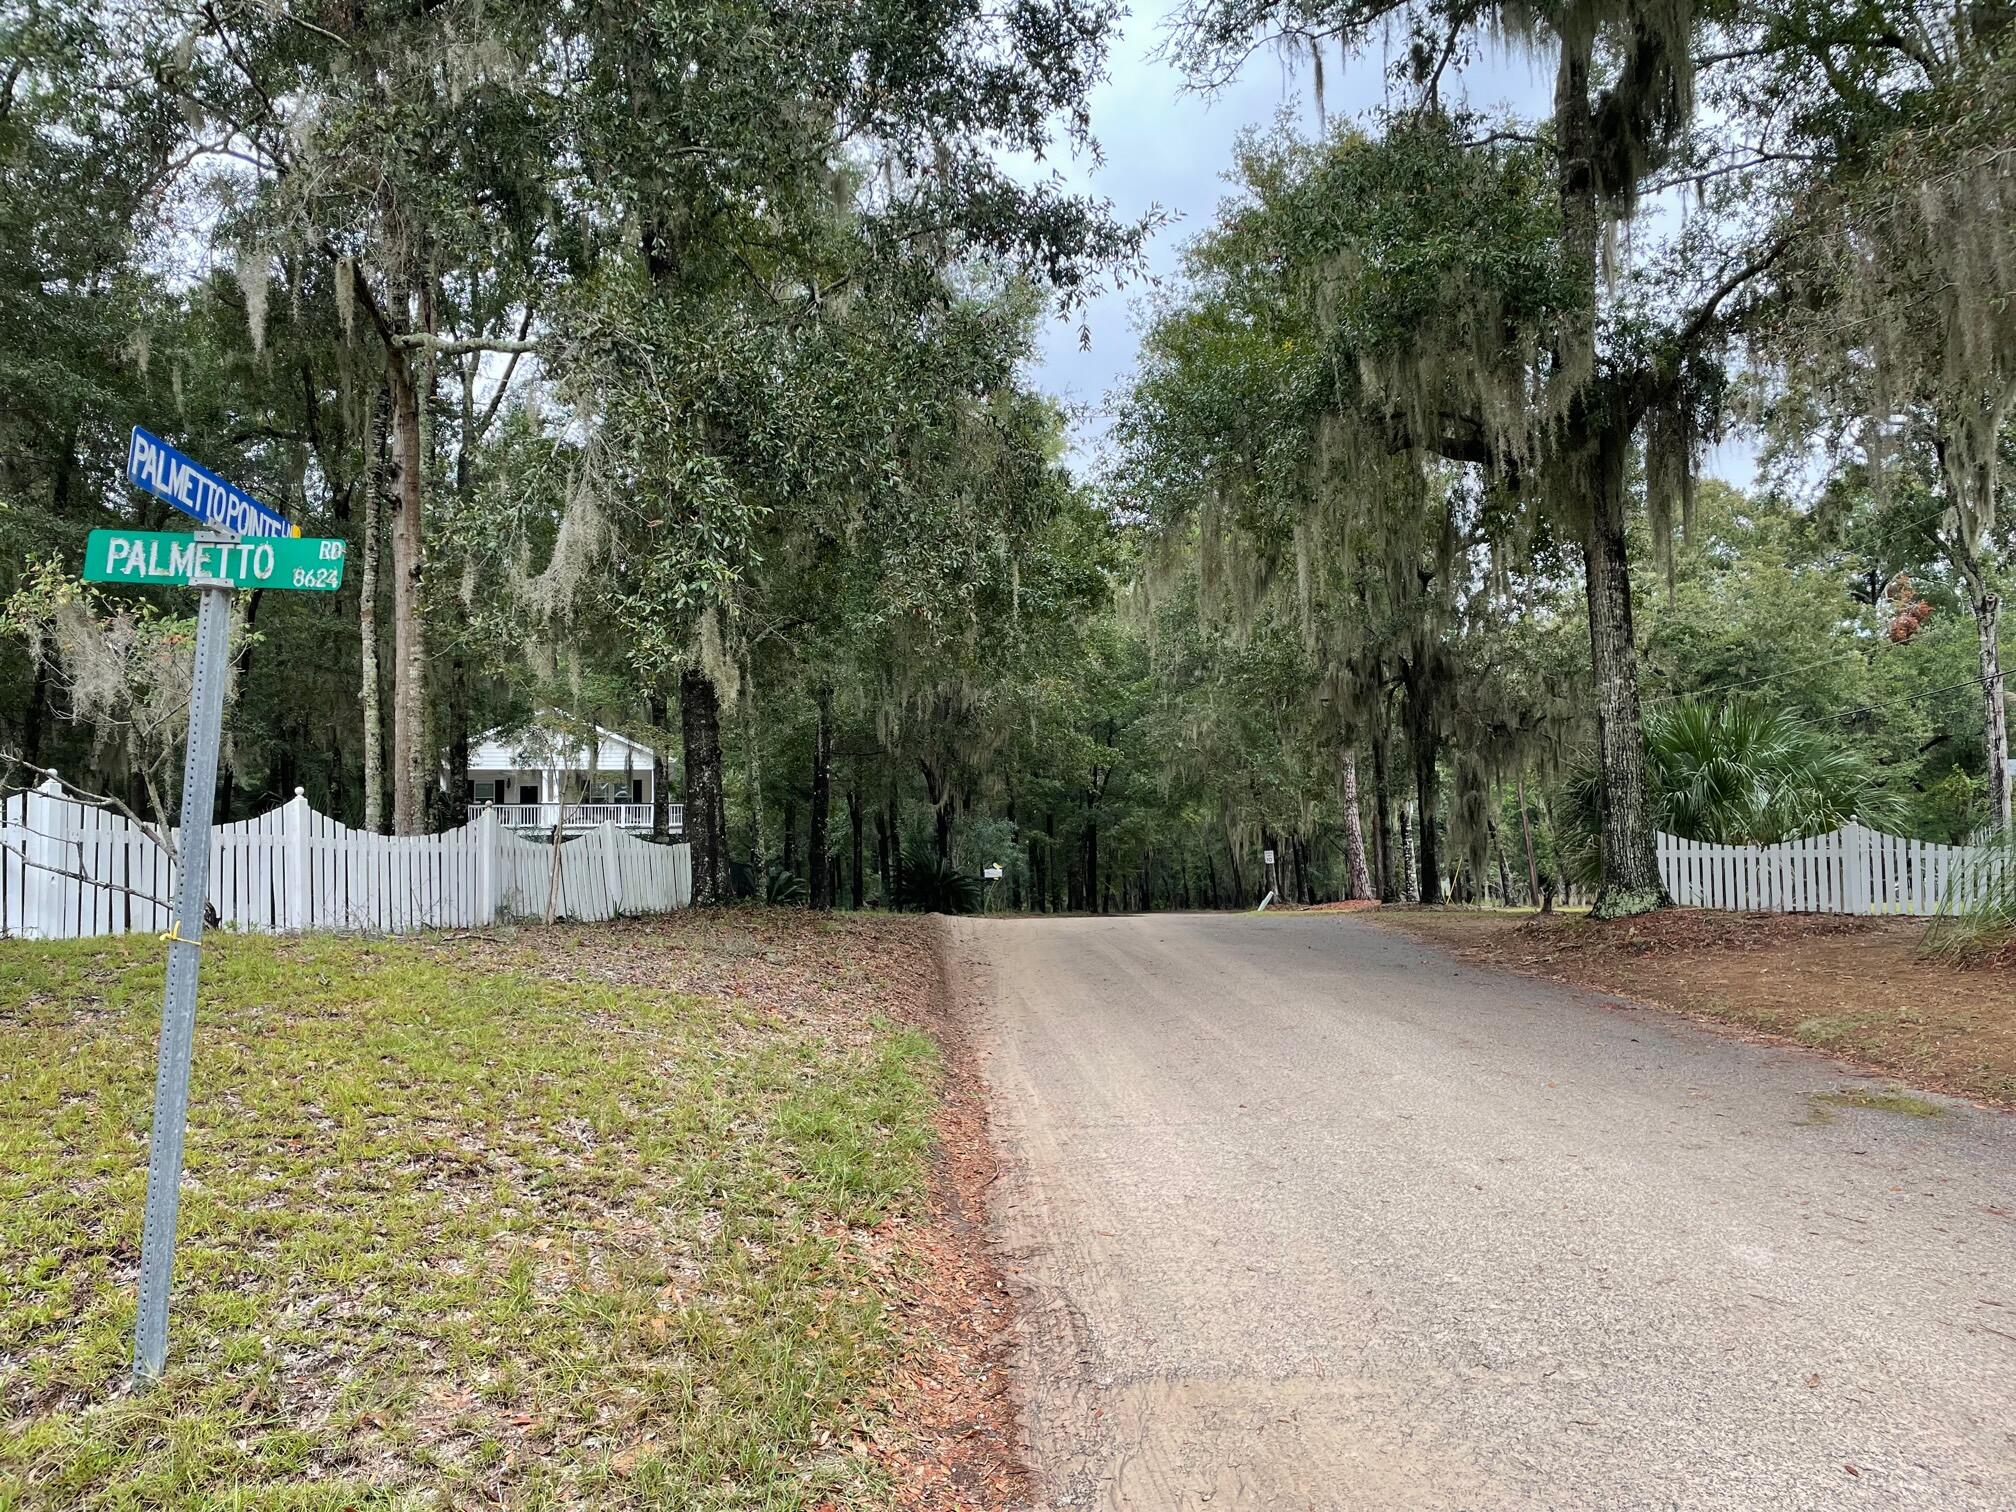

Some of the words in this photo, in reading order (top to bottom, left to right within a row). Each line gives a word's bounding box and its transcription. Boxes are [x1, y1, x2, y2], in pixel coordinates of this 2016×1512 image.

[106, 538, 274, 579] PALMETTO
[319, 541, 342, 560] RD
[293, 568, 338, 588] 8624
